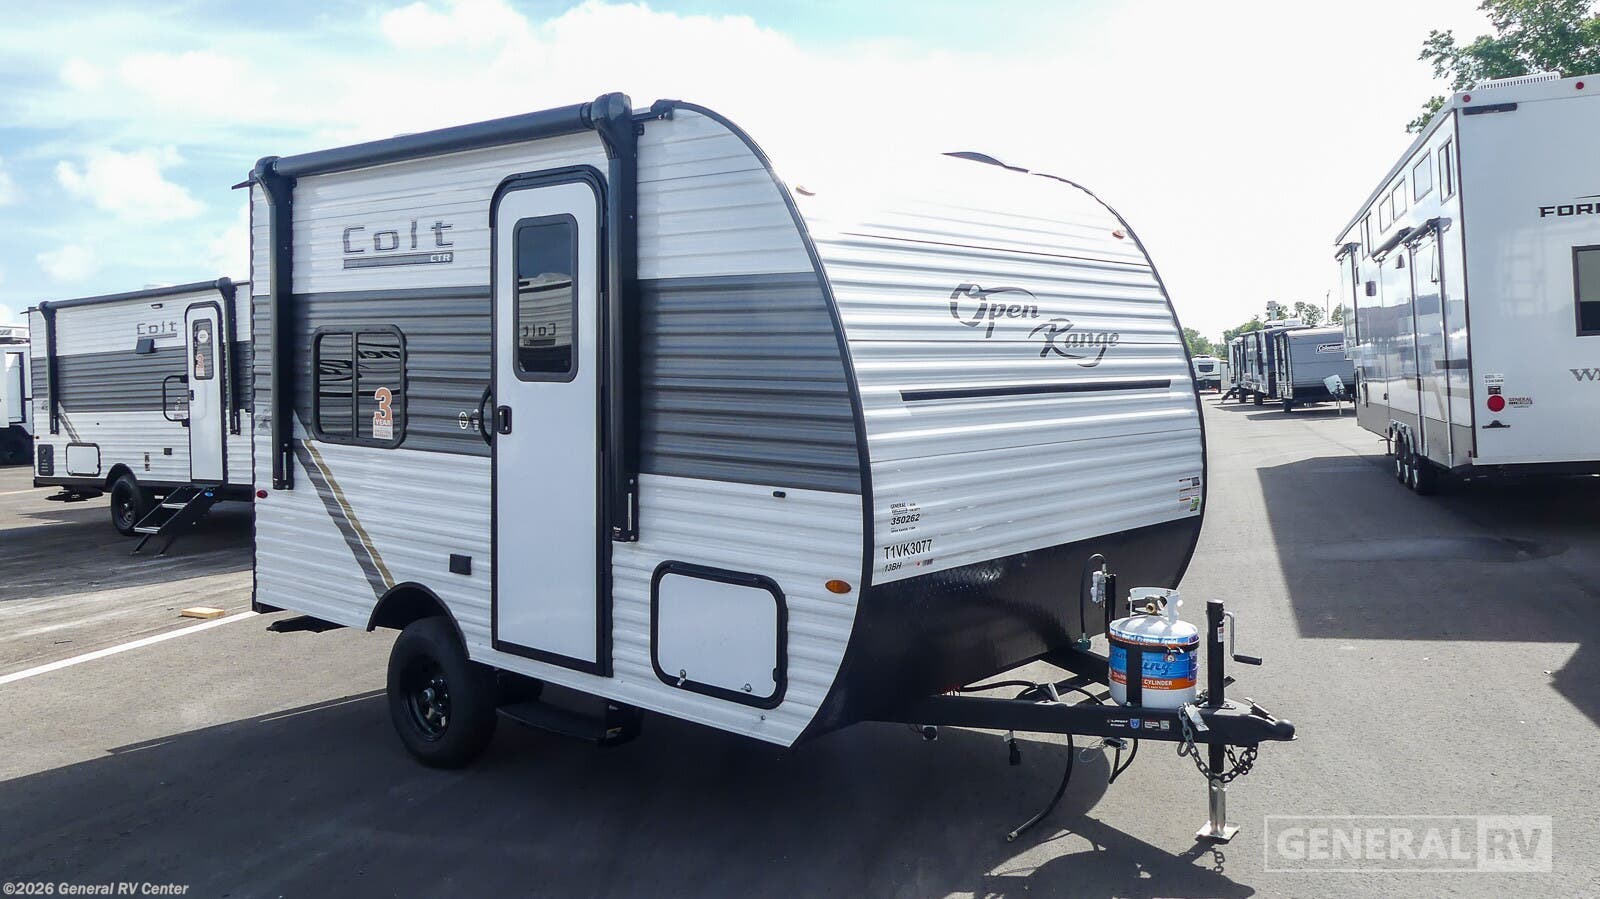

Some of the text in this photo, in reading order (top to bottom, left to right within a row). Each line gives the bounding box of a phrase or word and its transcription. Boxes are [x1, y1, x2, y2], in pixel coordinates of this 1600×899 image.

[1538, 202, 1600, 217] FOR
[343, 220, 453, 253] Colt
[430, 254, 451, 263] CTR
[950, 284, 1040, 338] Open
[137, 321, 177, 335] Colt
[1028, 318, 1120, 367] Range
[375, 387, 392, 420] 3
[891, 514, 920, 526] 350262
[884, 539, 932, 560] T1VK3077
[884, 562, 903, 573] 13BH
